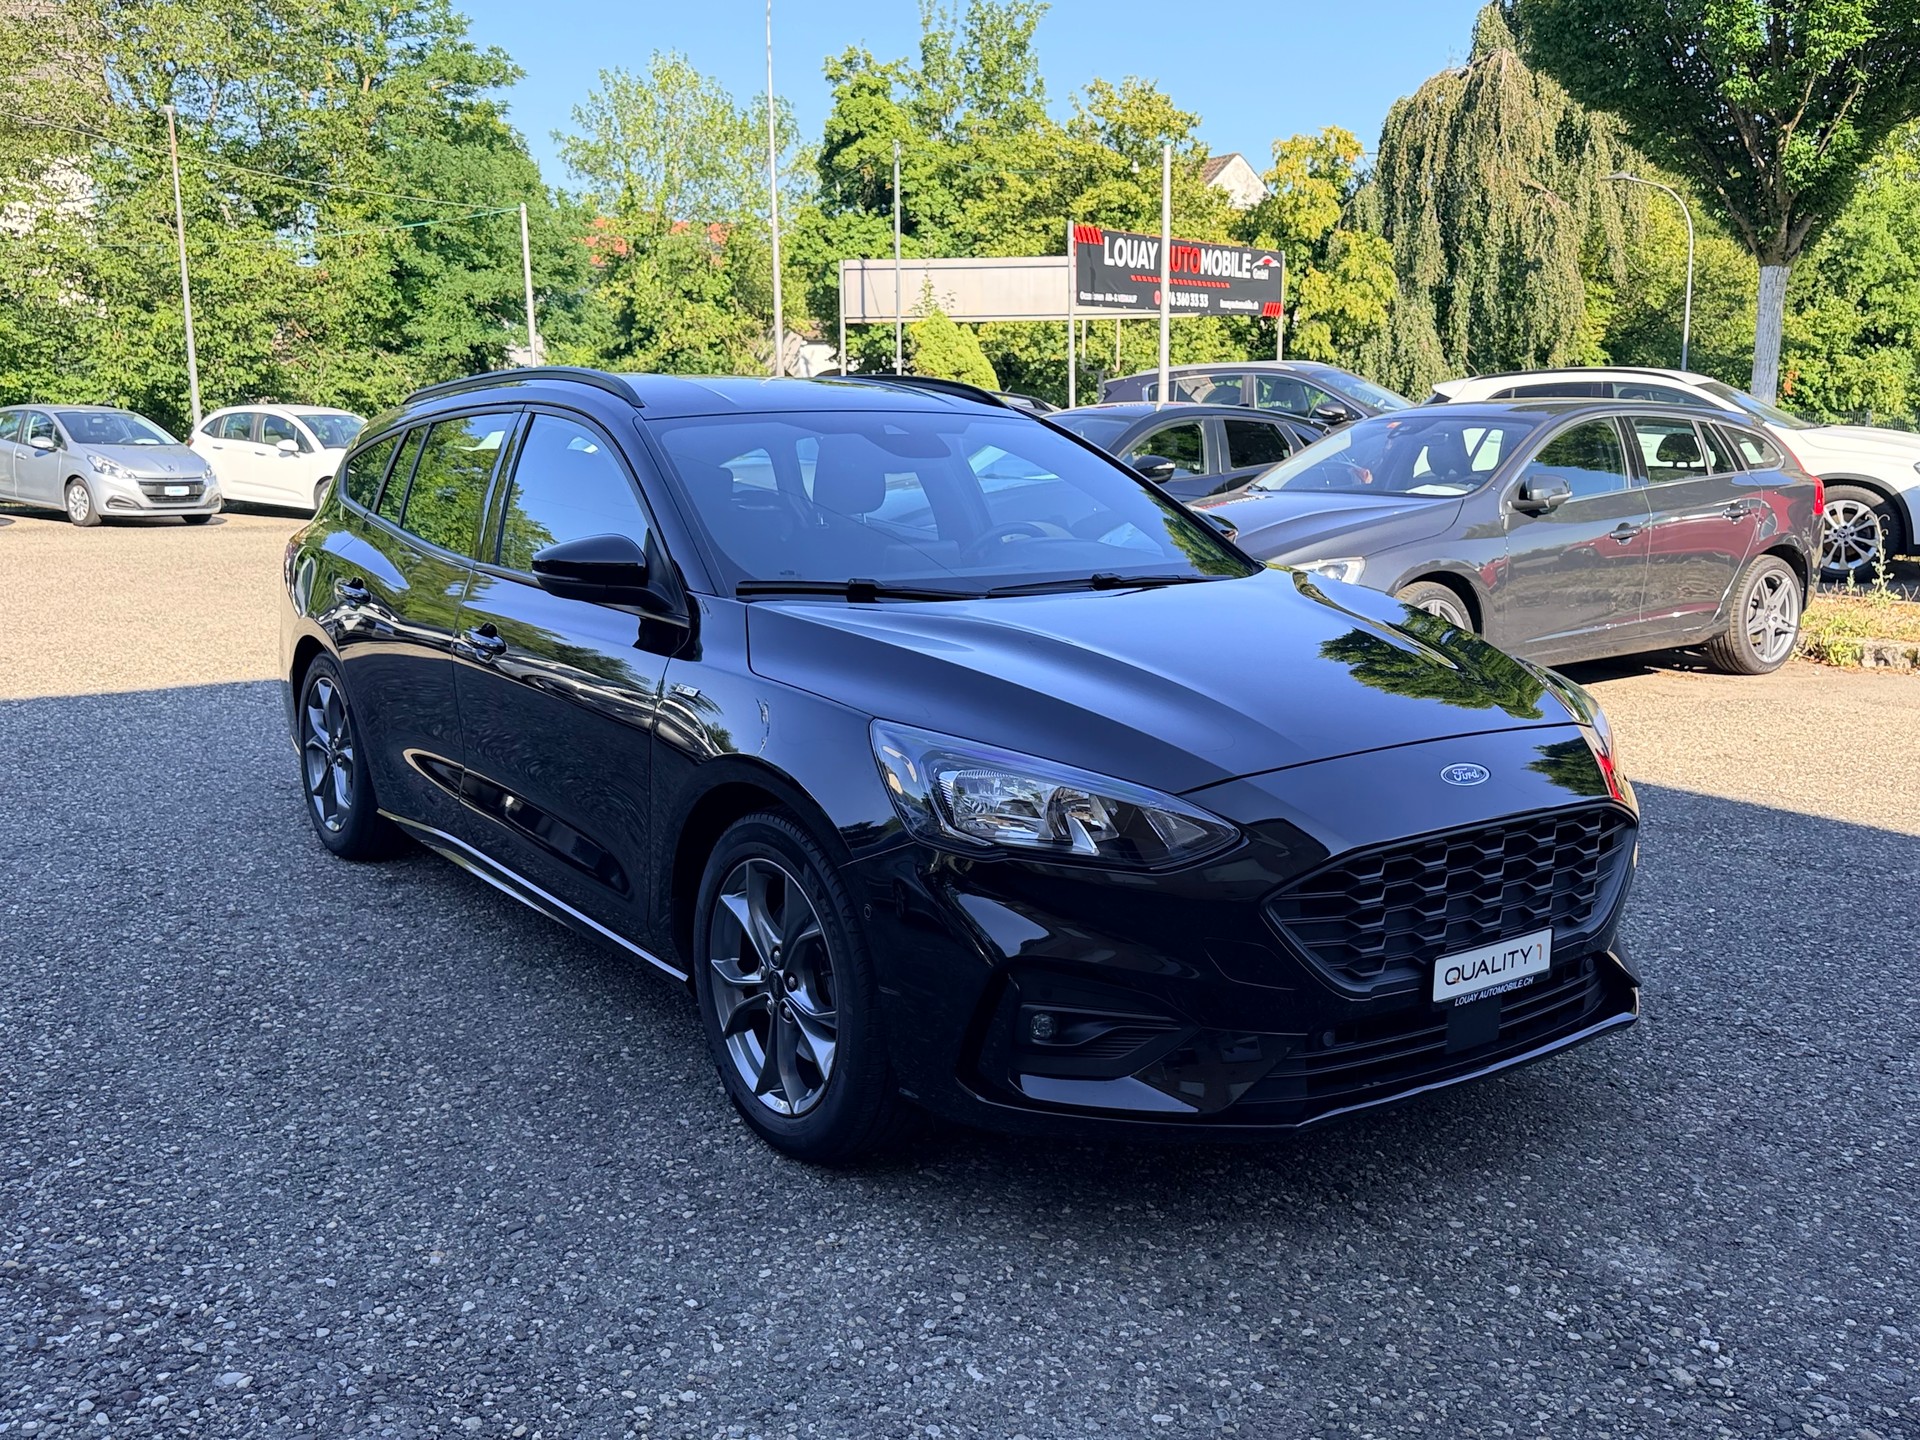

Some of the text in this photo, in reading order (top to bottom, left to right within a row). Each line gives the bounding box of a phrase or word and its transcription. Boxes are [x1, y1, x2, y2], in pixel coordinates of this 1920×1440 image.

[1103, 235, 1252, 279] LOUAY UTOMOBILE
[1452, 768, 1480, 781] Ford
[1444, 945, 1533, 986] QUALITY
[1454, 976, 1535, 1007] LOUAY AUTOMOBILE.CH
